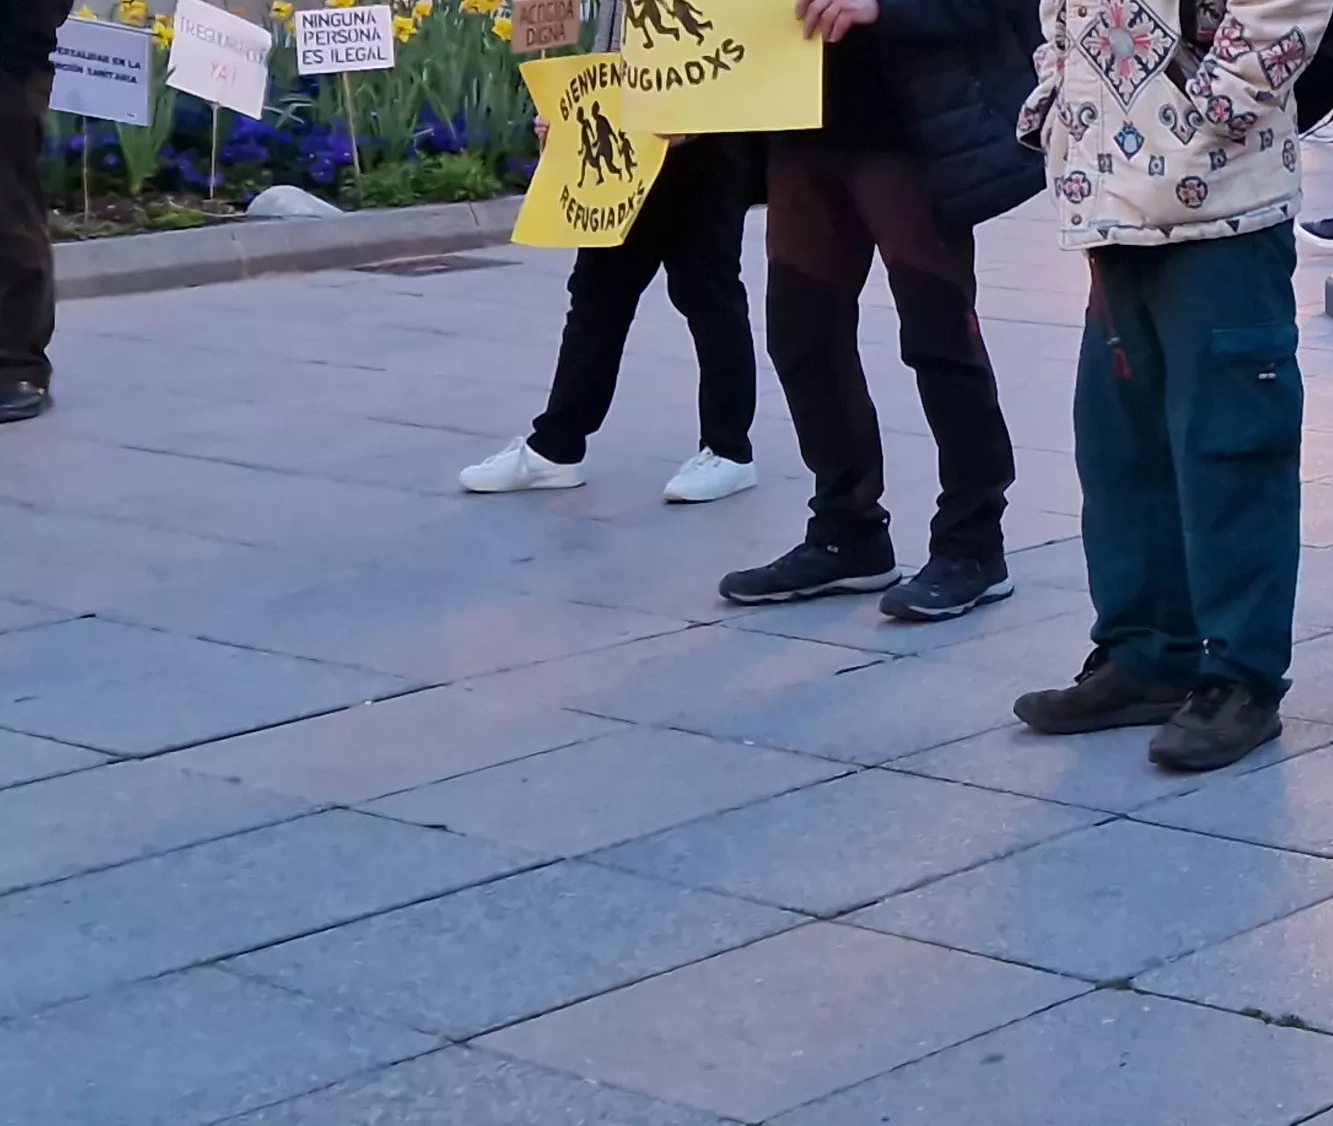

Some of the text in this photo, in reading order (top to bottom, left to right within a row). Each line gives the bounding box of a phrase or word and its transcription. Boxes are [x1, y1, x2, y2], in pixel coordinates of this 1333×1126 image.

[302, 10, 377, 29] NINGUNA
[303, 27, 381, 46] PERSONA
[526, 22, 566, 46] DIGNA
[128, 60, 142, 70] LA
[302, 46, 388, 65] ES ILEGAL
